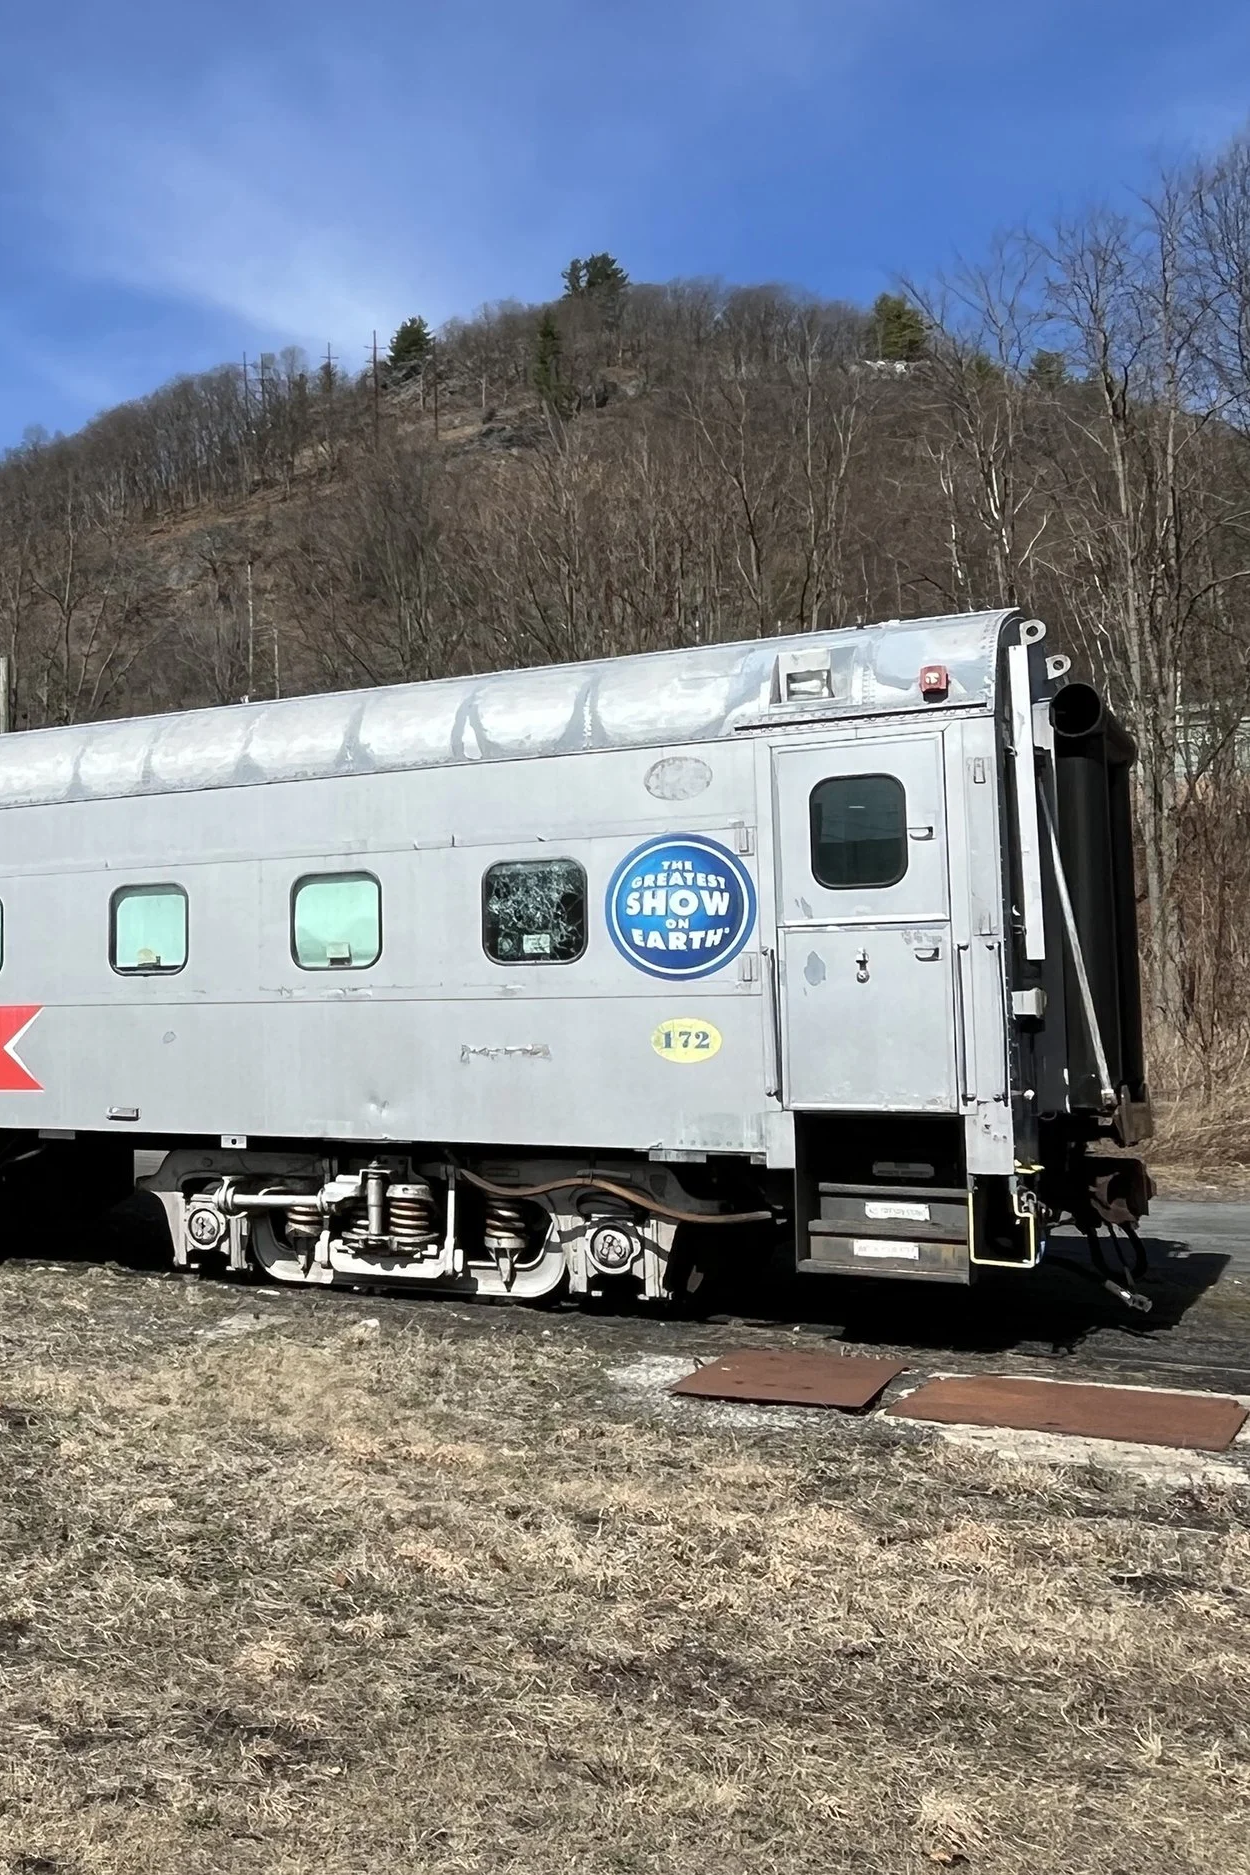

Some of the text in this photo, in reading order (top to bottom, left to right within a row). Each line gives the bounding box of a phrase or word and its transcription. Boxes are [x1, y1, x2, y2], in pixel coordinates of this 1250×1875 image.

[661, 860, 693, 871] THE
[631, 872, 726, 889] GREATEST
[625, 889, 730, 916] SHOW
[665, 918, 689, 929] ON
[663, 1030, 710, 1049] 172
